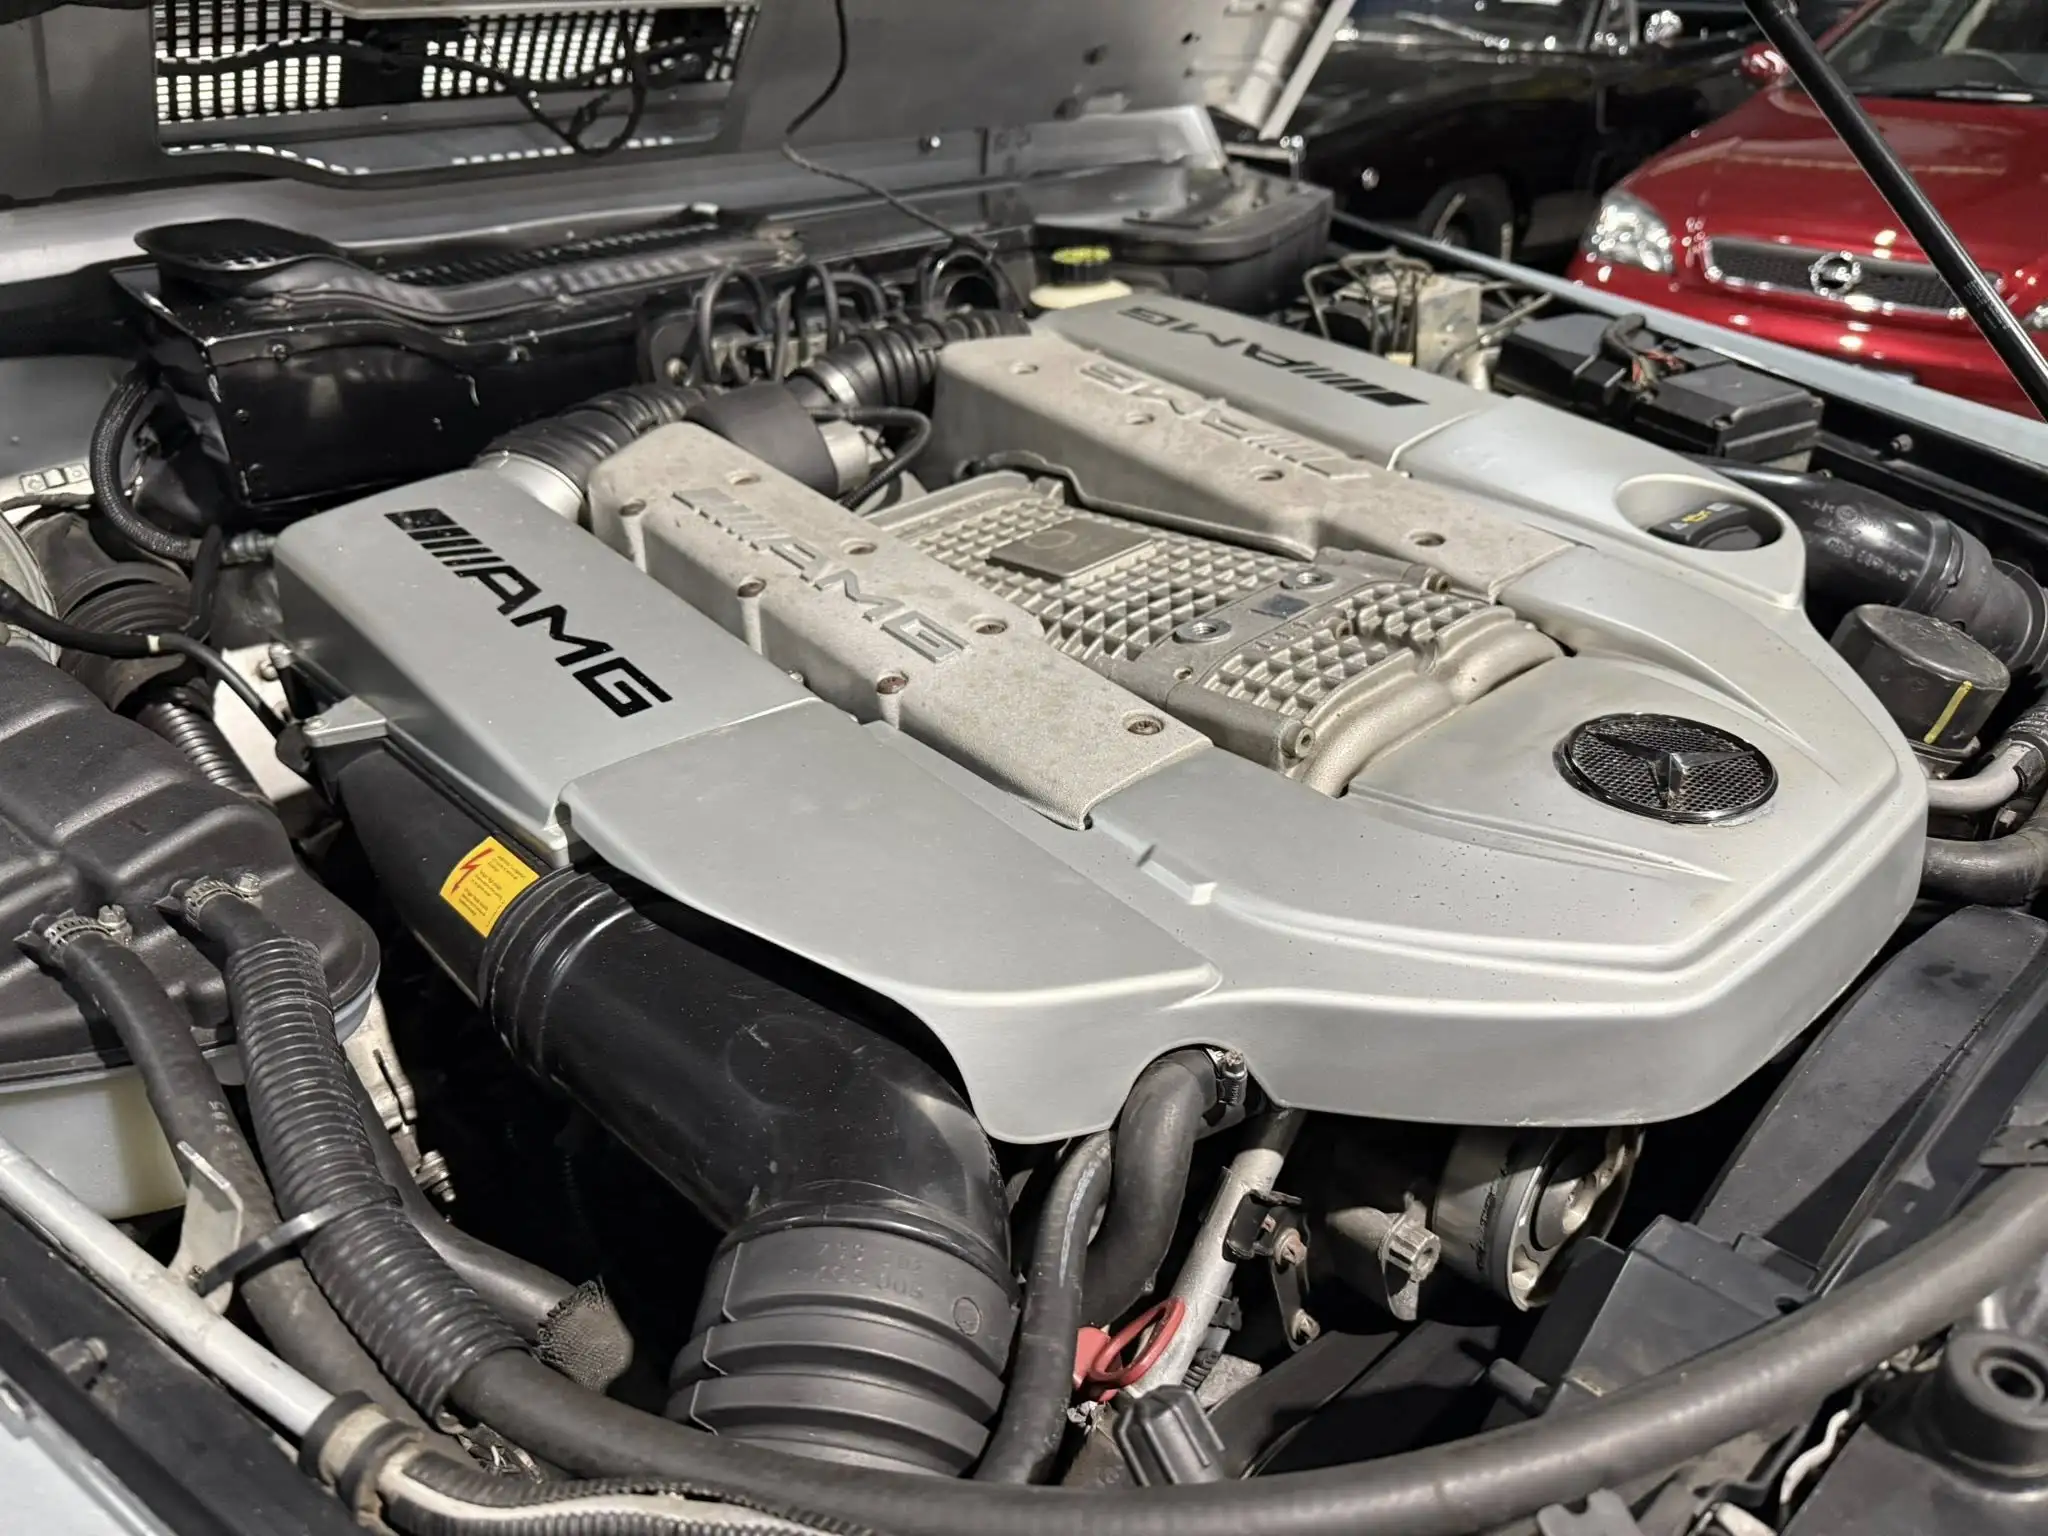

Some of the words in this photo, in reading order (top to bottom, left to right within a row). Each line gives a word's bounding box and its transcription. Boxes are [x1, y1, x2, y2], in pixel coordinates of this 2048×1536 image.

[1118, 306, 1315, 369] AMG
[453, 565, 673, 718] AMG
[750, 534, 971, 664] AMG
